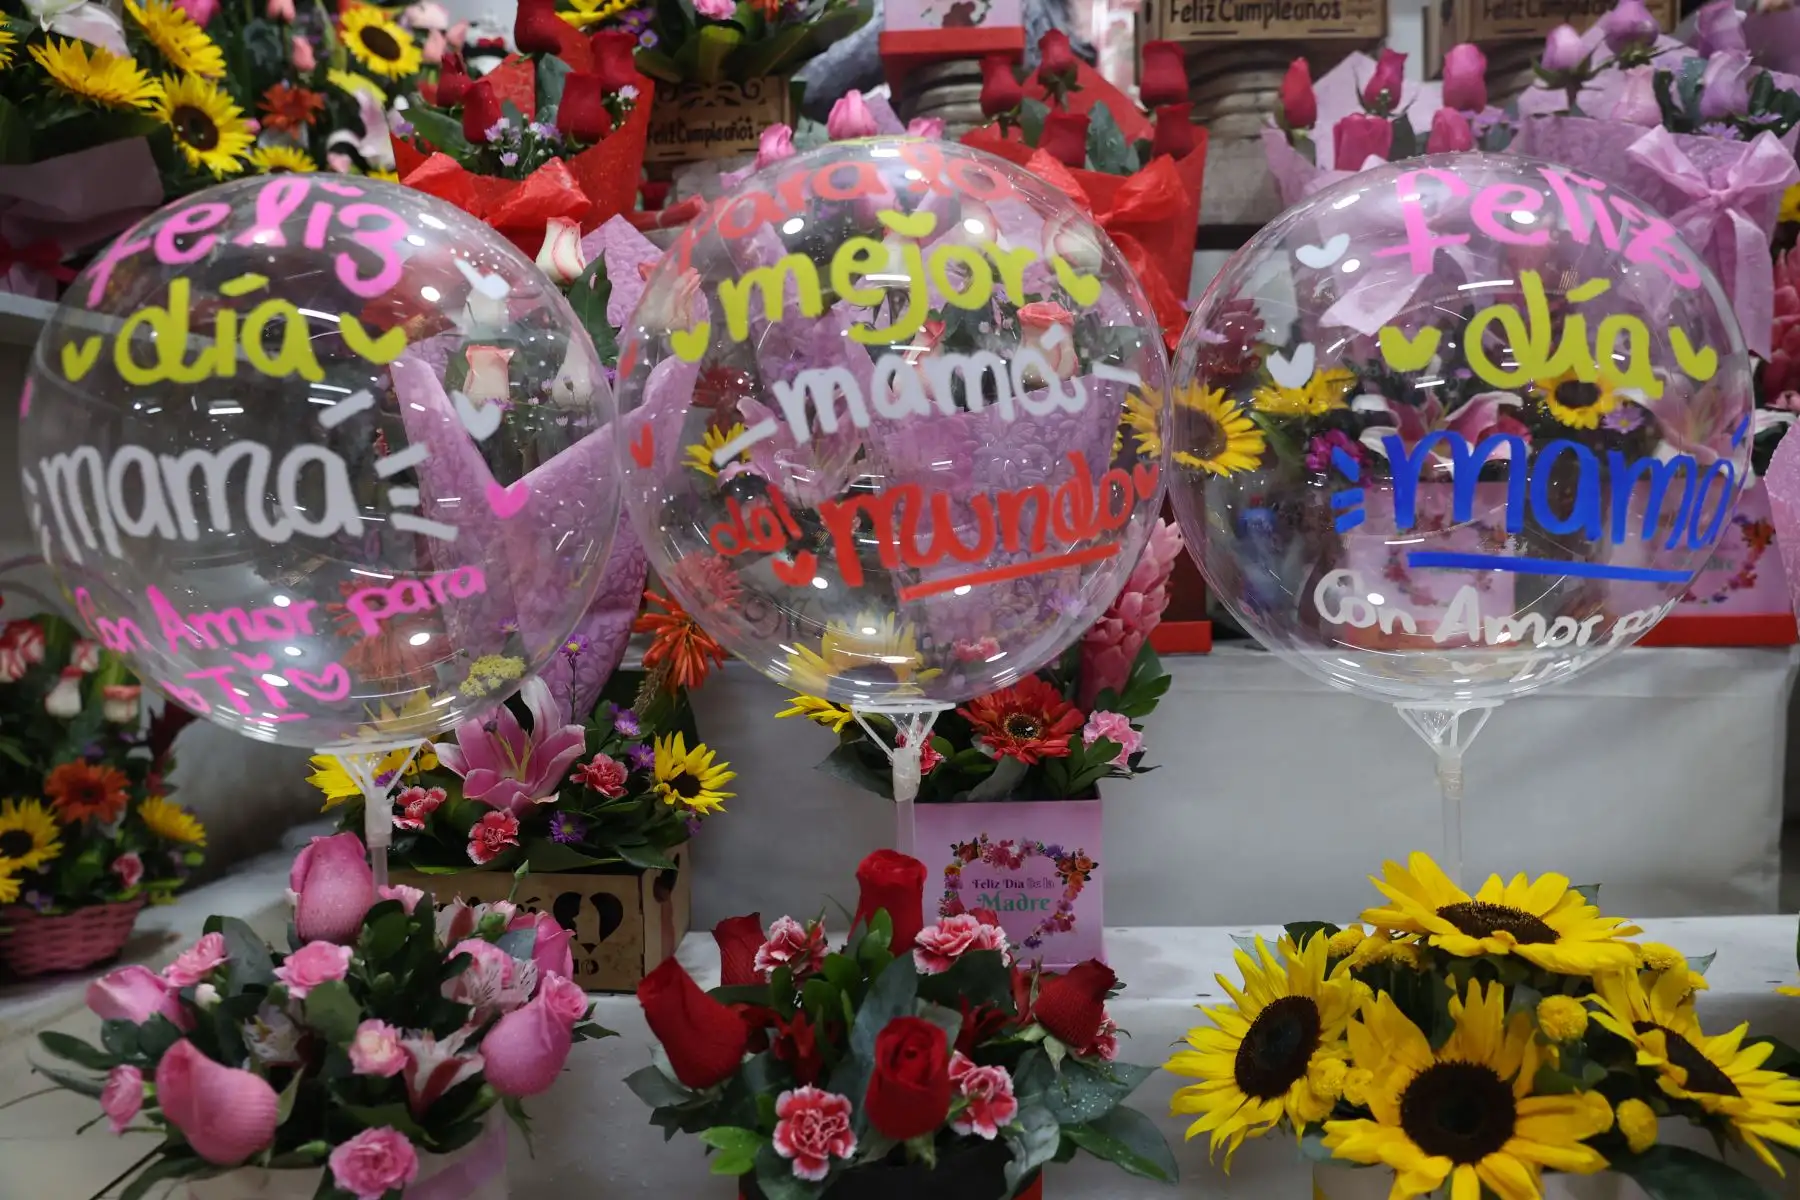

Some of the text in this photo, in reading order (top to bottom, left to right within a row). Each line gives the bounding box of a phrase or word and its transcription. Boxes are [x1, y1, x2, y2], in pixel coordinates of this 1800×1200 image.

[1171, 0, 1214, 23] Feliz
[718, 209, 1038, 344] mejor
[114, 272, 325, 385] día
[1464, 269, 1664, 399] día
[772, 324, 1088, 444] mamá
[820, 451, 1134, 588] mundo
[147, 583, 317, 654] Amor
[346, 565, 487, 635] para
[1313, 568, 1417, 636] Con
[1432, 585, 1604, 647] Amor
[972, 879, 1000, 889] Feliz
[977, 891, 1051, 911] Madre
